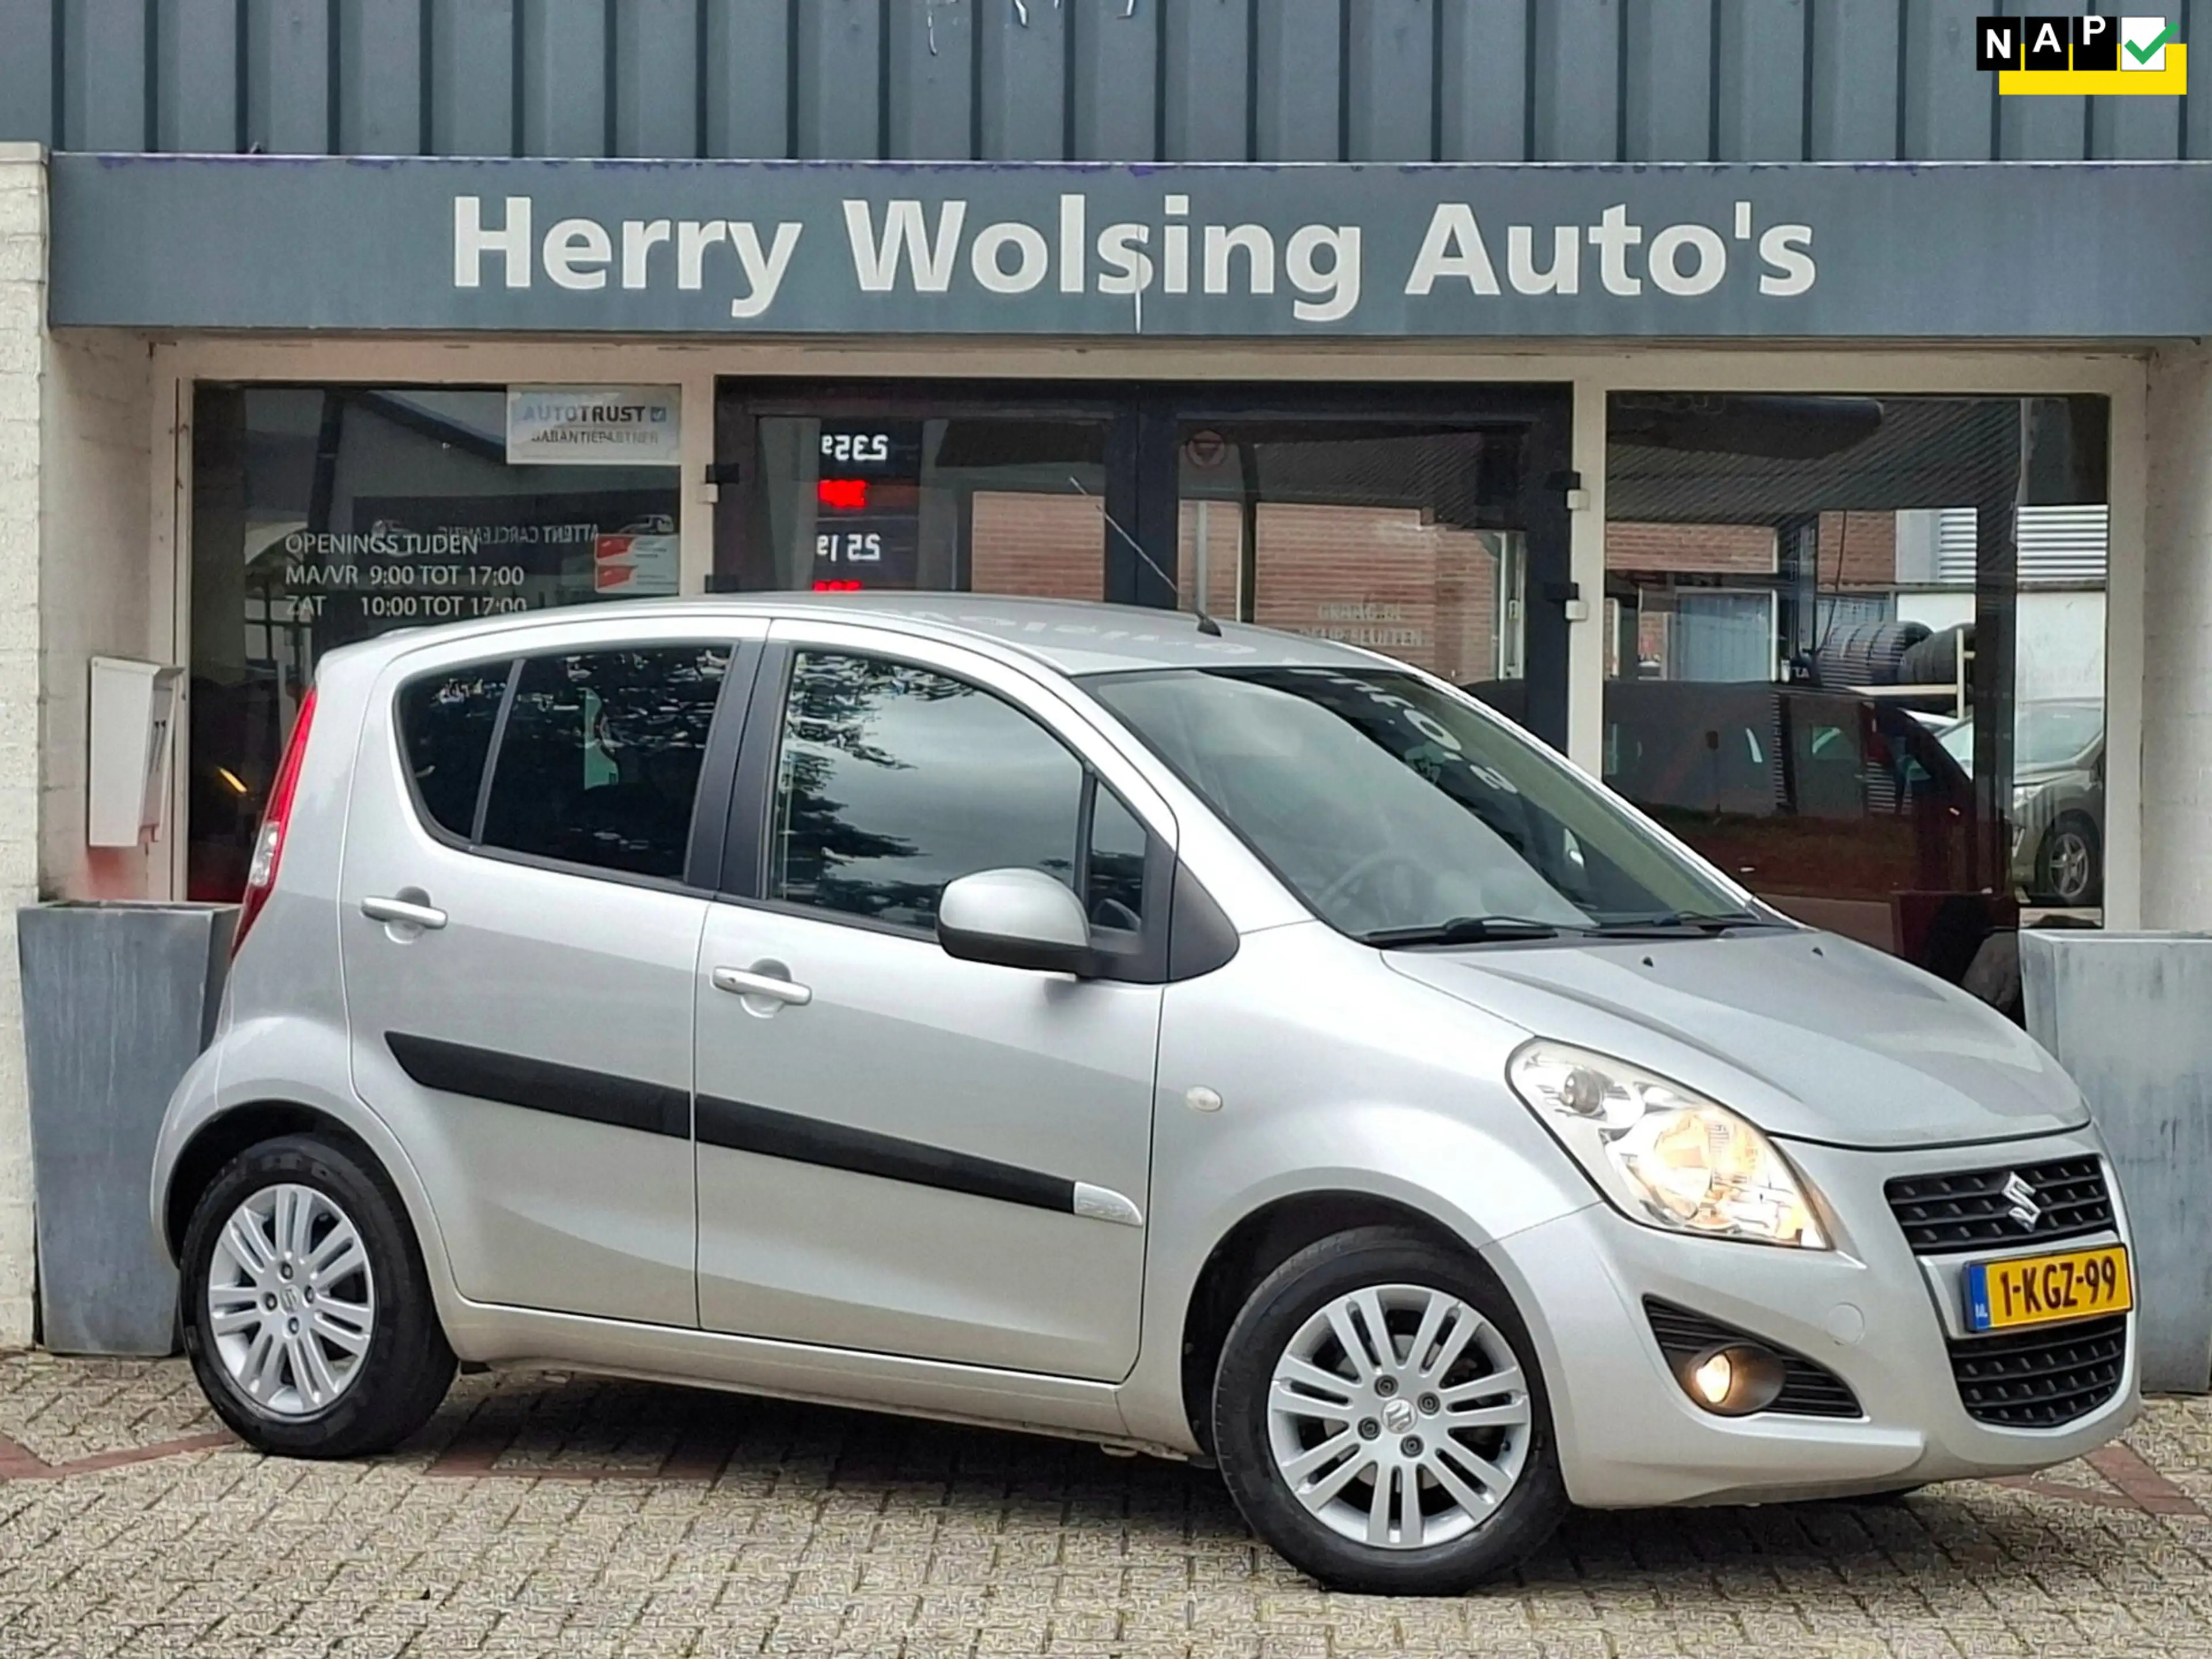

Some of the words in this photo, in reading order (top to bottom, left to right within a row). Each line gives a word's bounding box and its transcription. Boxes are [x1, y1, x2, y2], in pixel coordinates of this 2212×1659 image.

[453, 196, 803, 317] Herry
[842, 194, 1361, 321] Wolsing
[1404, 201, 1817, 296] Auto's
[523, 406, 646, 422] AUTOTRUST
[285, 565, 358, 585] MA/VR
[369, 565, 415, 585] 9:00
[419, 565, 461, 586] TOT
[468, 565, 525, 586] 17:00
[285, 595, 327, 616] ZAT
[361, 596, 416, 617] 10:00
[420, 595, 464, 618] TOT
[469, 596, 528, 616] 17:00
[1999, 1255, 2116, 1317] 1-KGZ-99
